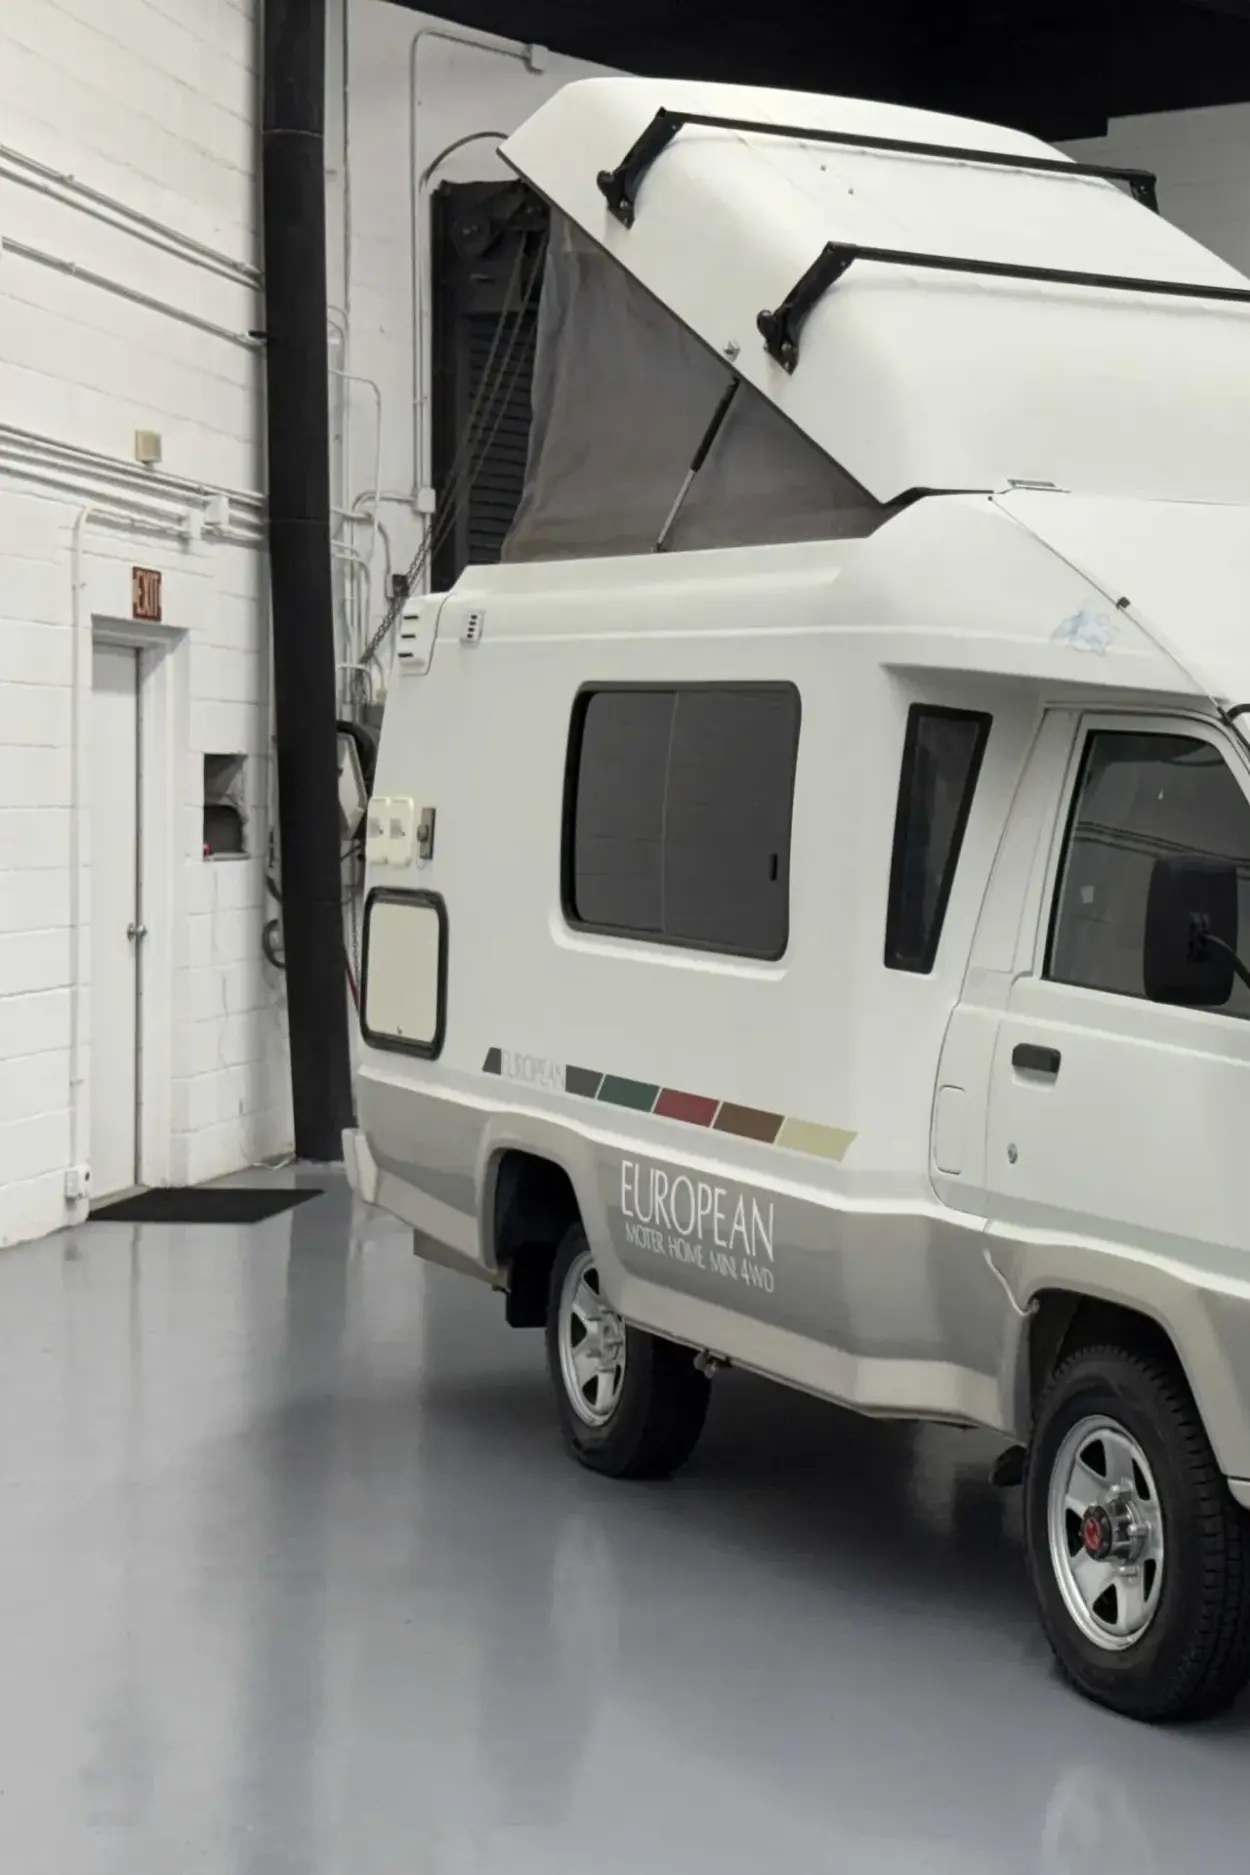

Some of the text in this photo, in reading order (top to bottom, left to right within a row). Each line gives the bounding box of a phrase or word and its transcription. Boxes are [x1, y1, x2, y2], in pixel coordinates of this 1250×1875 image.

[135, 570, 159, 617] EXIT
[501, 1048, 566, 1092] EUROPEAN
[621, 1159, 775, 1263] EUROPEAN
[625, 1221, 666, 1255] MOTER
[668, 1235, 706, 1270] HOME
[740, 1257, 775, 1293] 4WD
